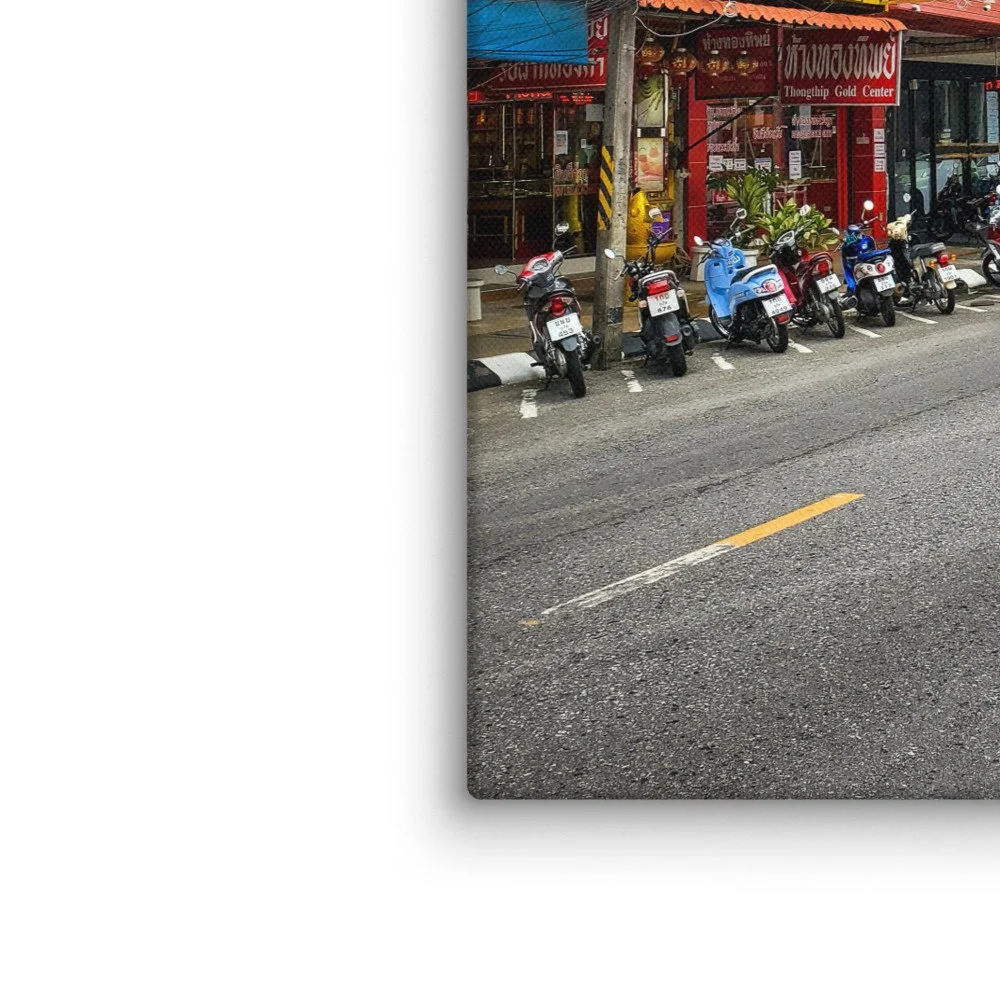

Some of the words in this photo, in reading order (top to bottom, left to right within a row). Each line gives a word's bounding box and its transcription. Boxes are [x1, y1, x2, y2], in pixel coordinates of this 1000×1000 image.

[784, 31, 897, 80] ห้างทองทิพย์
[784, 85, 829, 100] Thongthip
[835, 85, 857, 97] Gold
[862, 85, 895, 97] Center
